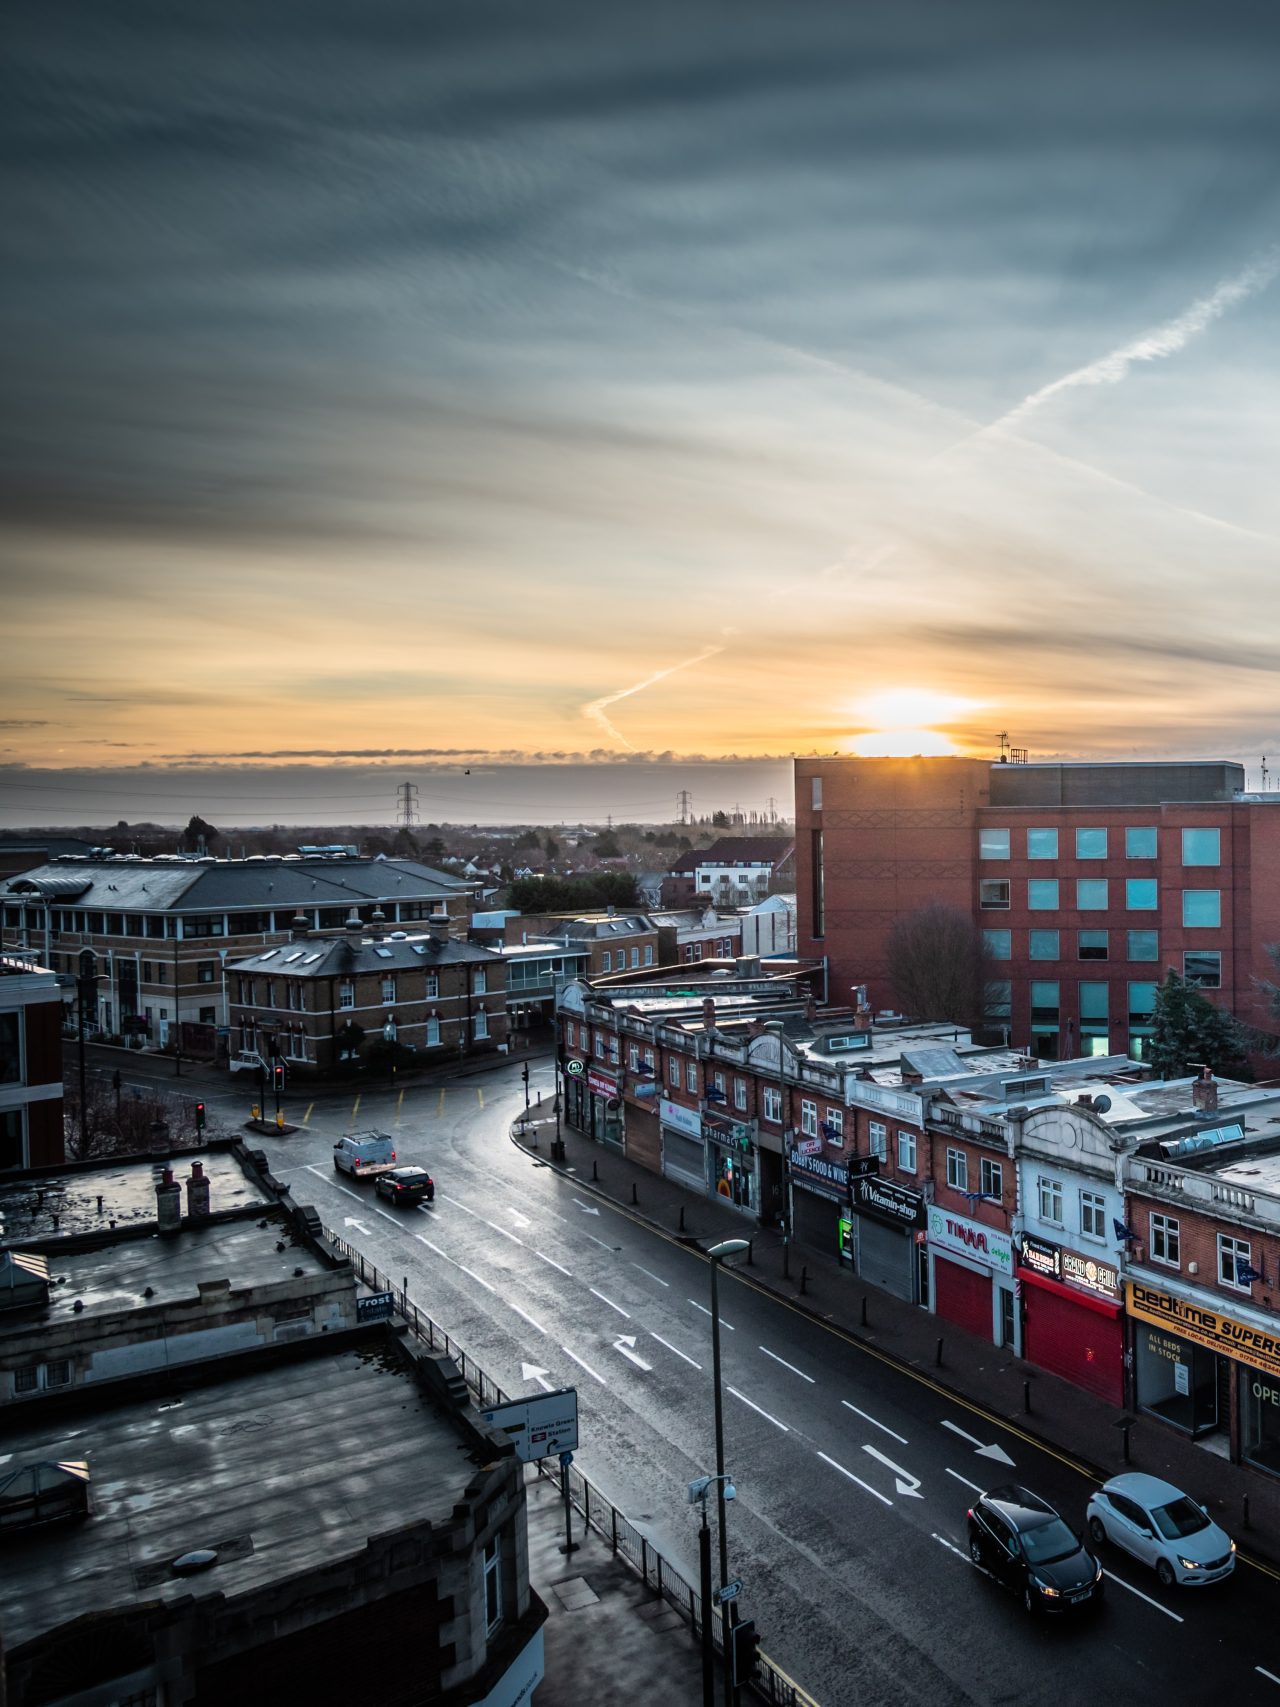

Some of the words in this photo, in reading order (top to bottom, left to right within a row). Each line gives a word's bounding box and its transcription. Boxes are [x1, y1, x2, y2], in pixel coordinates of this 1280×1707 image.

[813, 1158, 827, 1176] FOOD
[833, 1166, 848, 1184] WINE
[869, 1186, 917, 1220] Vitamin-shop
[946, 1219, 989, 1254] TIKKA
[1063, 1253, 1086, 1276] GRAND
[1097, 1267, 1117, 1289] GRILL
[358, 1295, 390, 1309] Frost
[1133, 1284, 1216, 1329] bedtime
[1149, 1334, 1161, 1345] ALL
[1163, 1339, 1181, 1353] BEDS
[1173, 1325, 1187, 1335] FREE
[1188, 1331, 1205, 1343] LOCAL
[1206, 1339, 1234, 1354] DELIVERY
[1149, 1344, 1156, 1352] IN
[1158, 1347, 1182, 1363] STOCK
[548, 1427, 571, 1437] Station
[556, 1418, 575, 1427] Green
